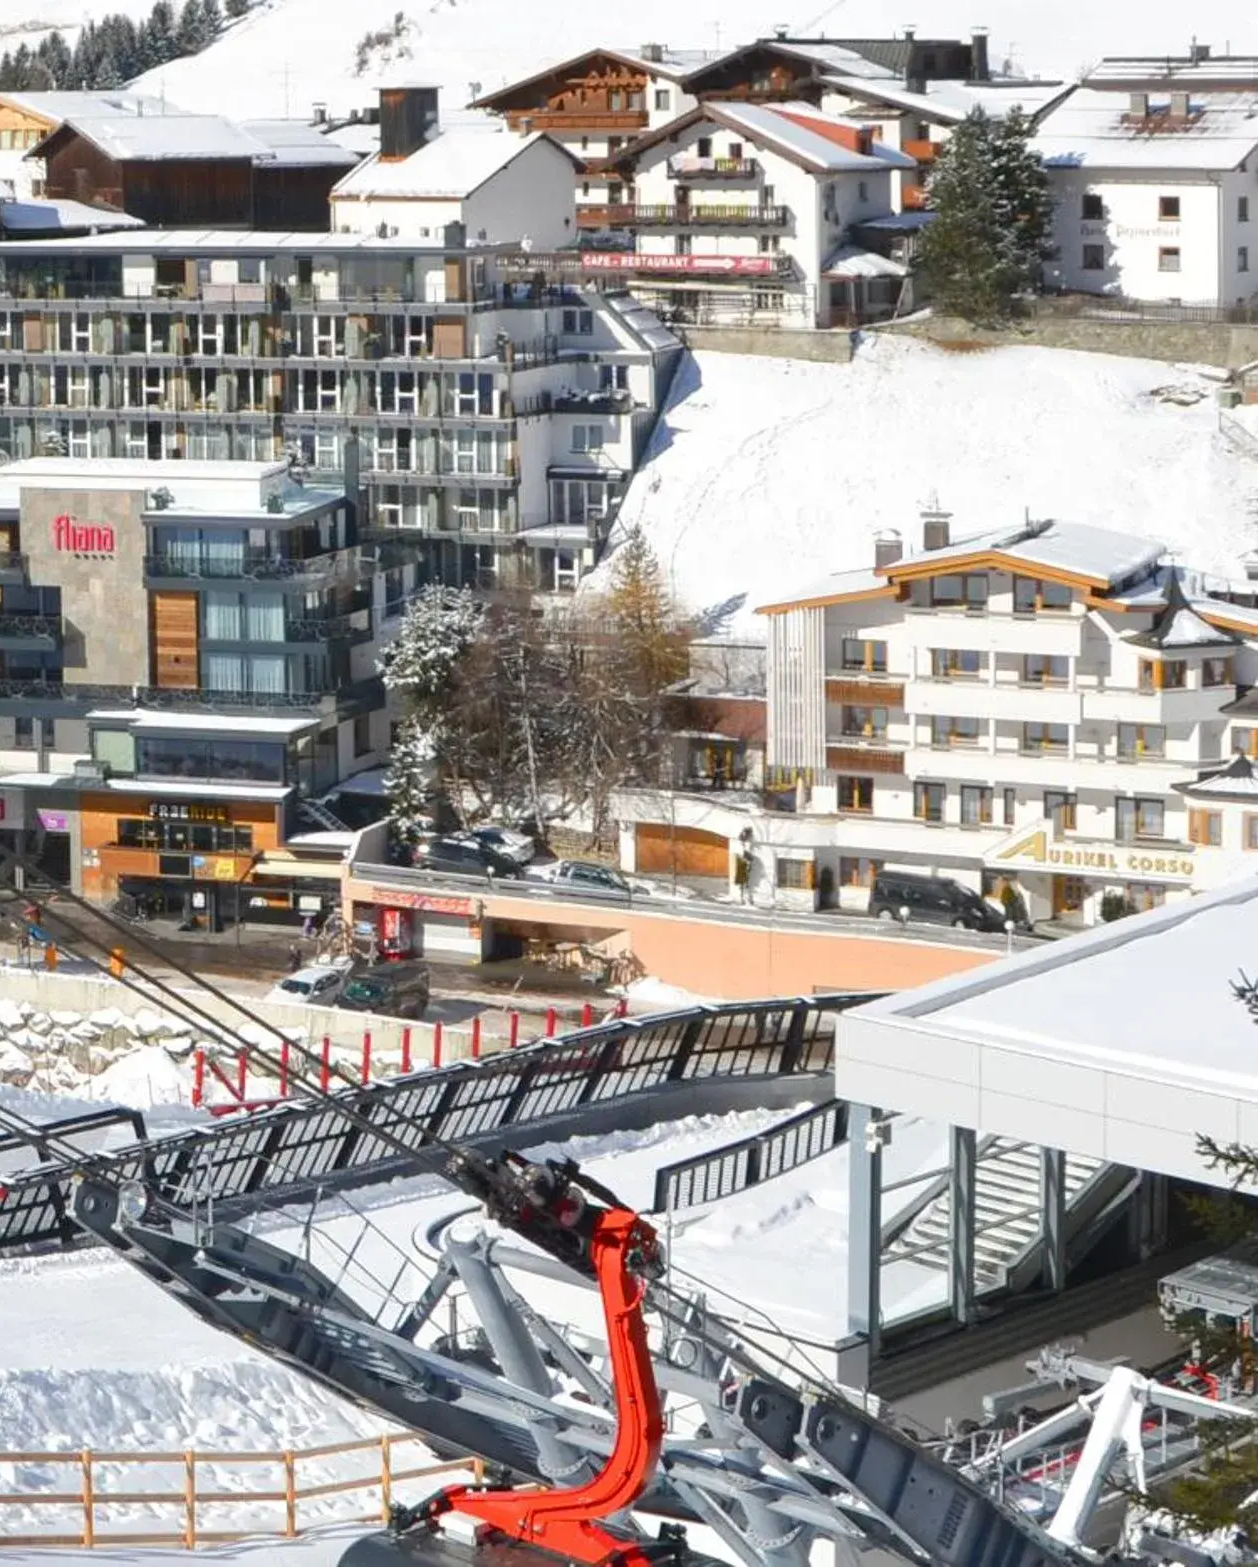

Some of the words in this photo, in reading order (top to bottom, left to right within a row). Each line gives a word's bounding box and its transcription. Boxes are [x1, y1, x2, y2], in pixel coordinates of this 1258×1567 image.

[621, 255, 690, 269] RESTAURANT
[54, 513, 114, 552] fliana
[996, 831, 1117, 869] AURIKEL
[1127, 855, 1194, 875] CORSO
